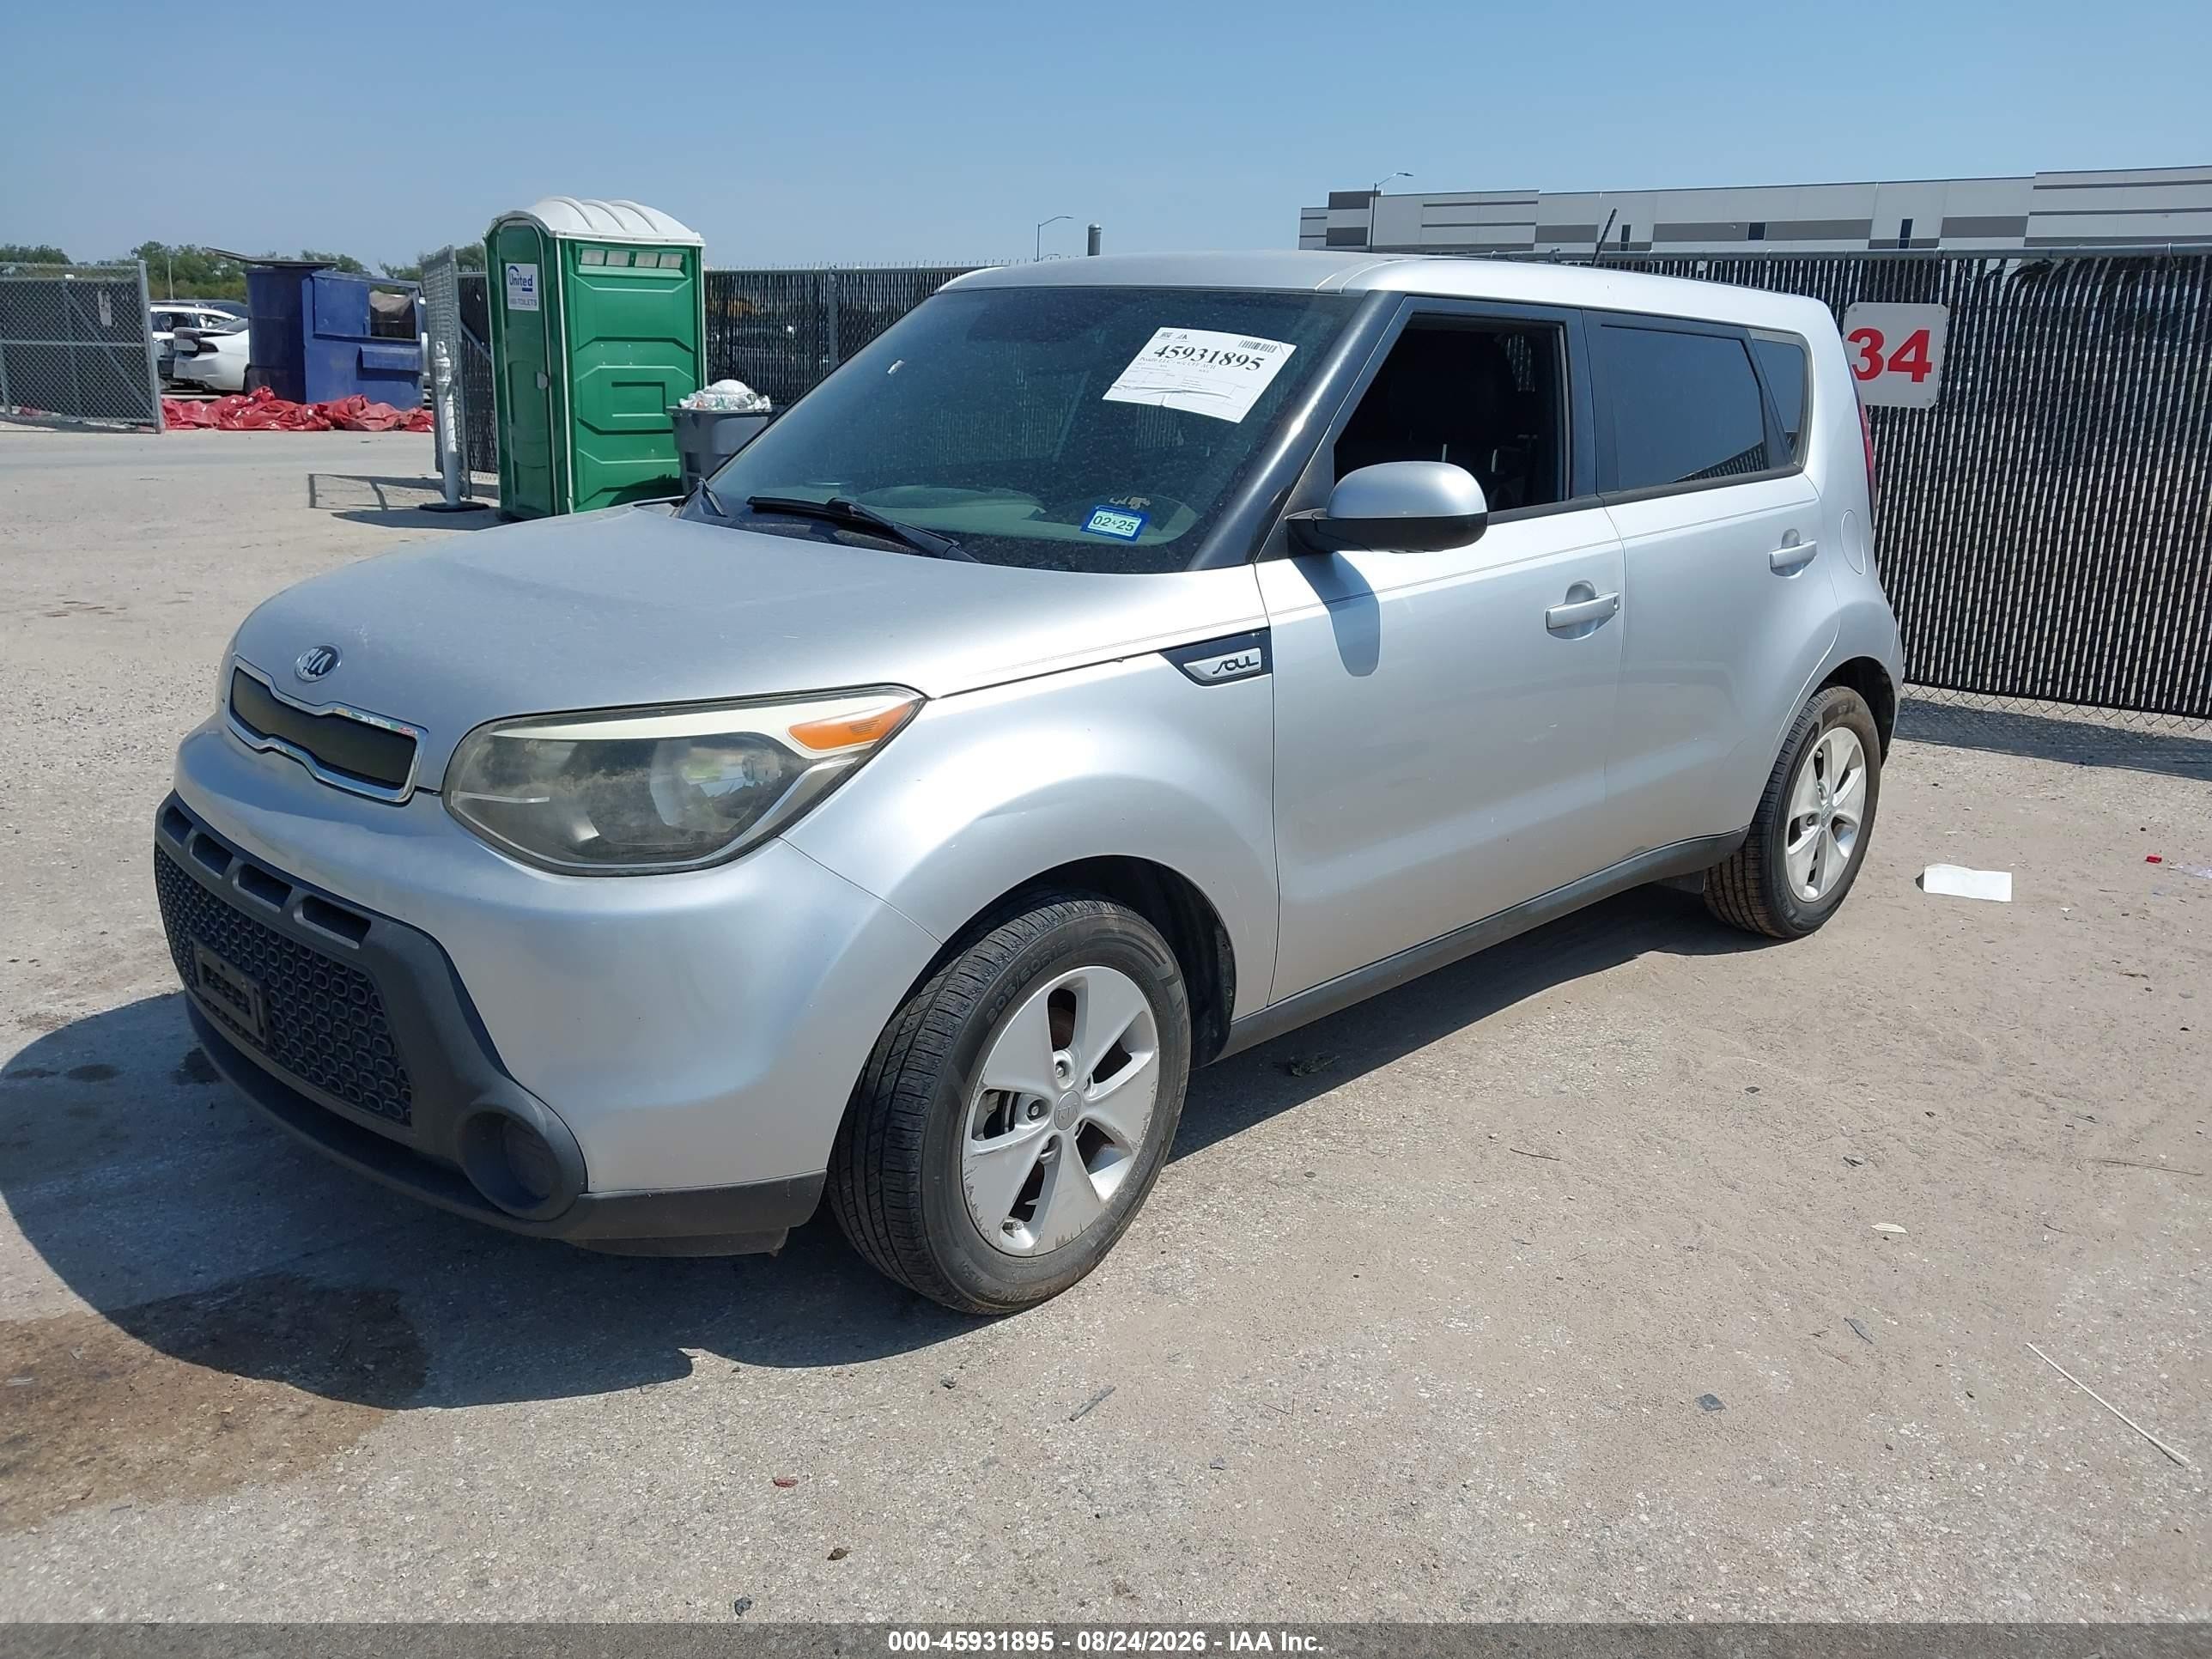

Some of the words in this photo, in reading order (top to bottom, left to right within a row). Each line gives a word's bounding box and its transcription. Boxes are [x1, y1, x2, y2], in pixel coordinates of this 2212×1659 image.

[508, 274, 533, 287] United
[1153, 344, 1265, 372] 45931895
[1848, 328, 1932, 383] 34
[1212, 655, 1259, 675] SOUL
